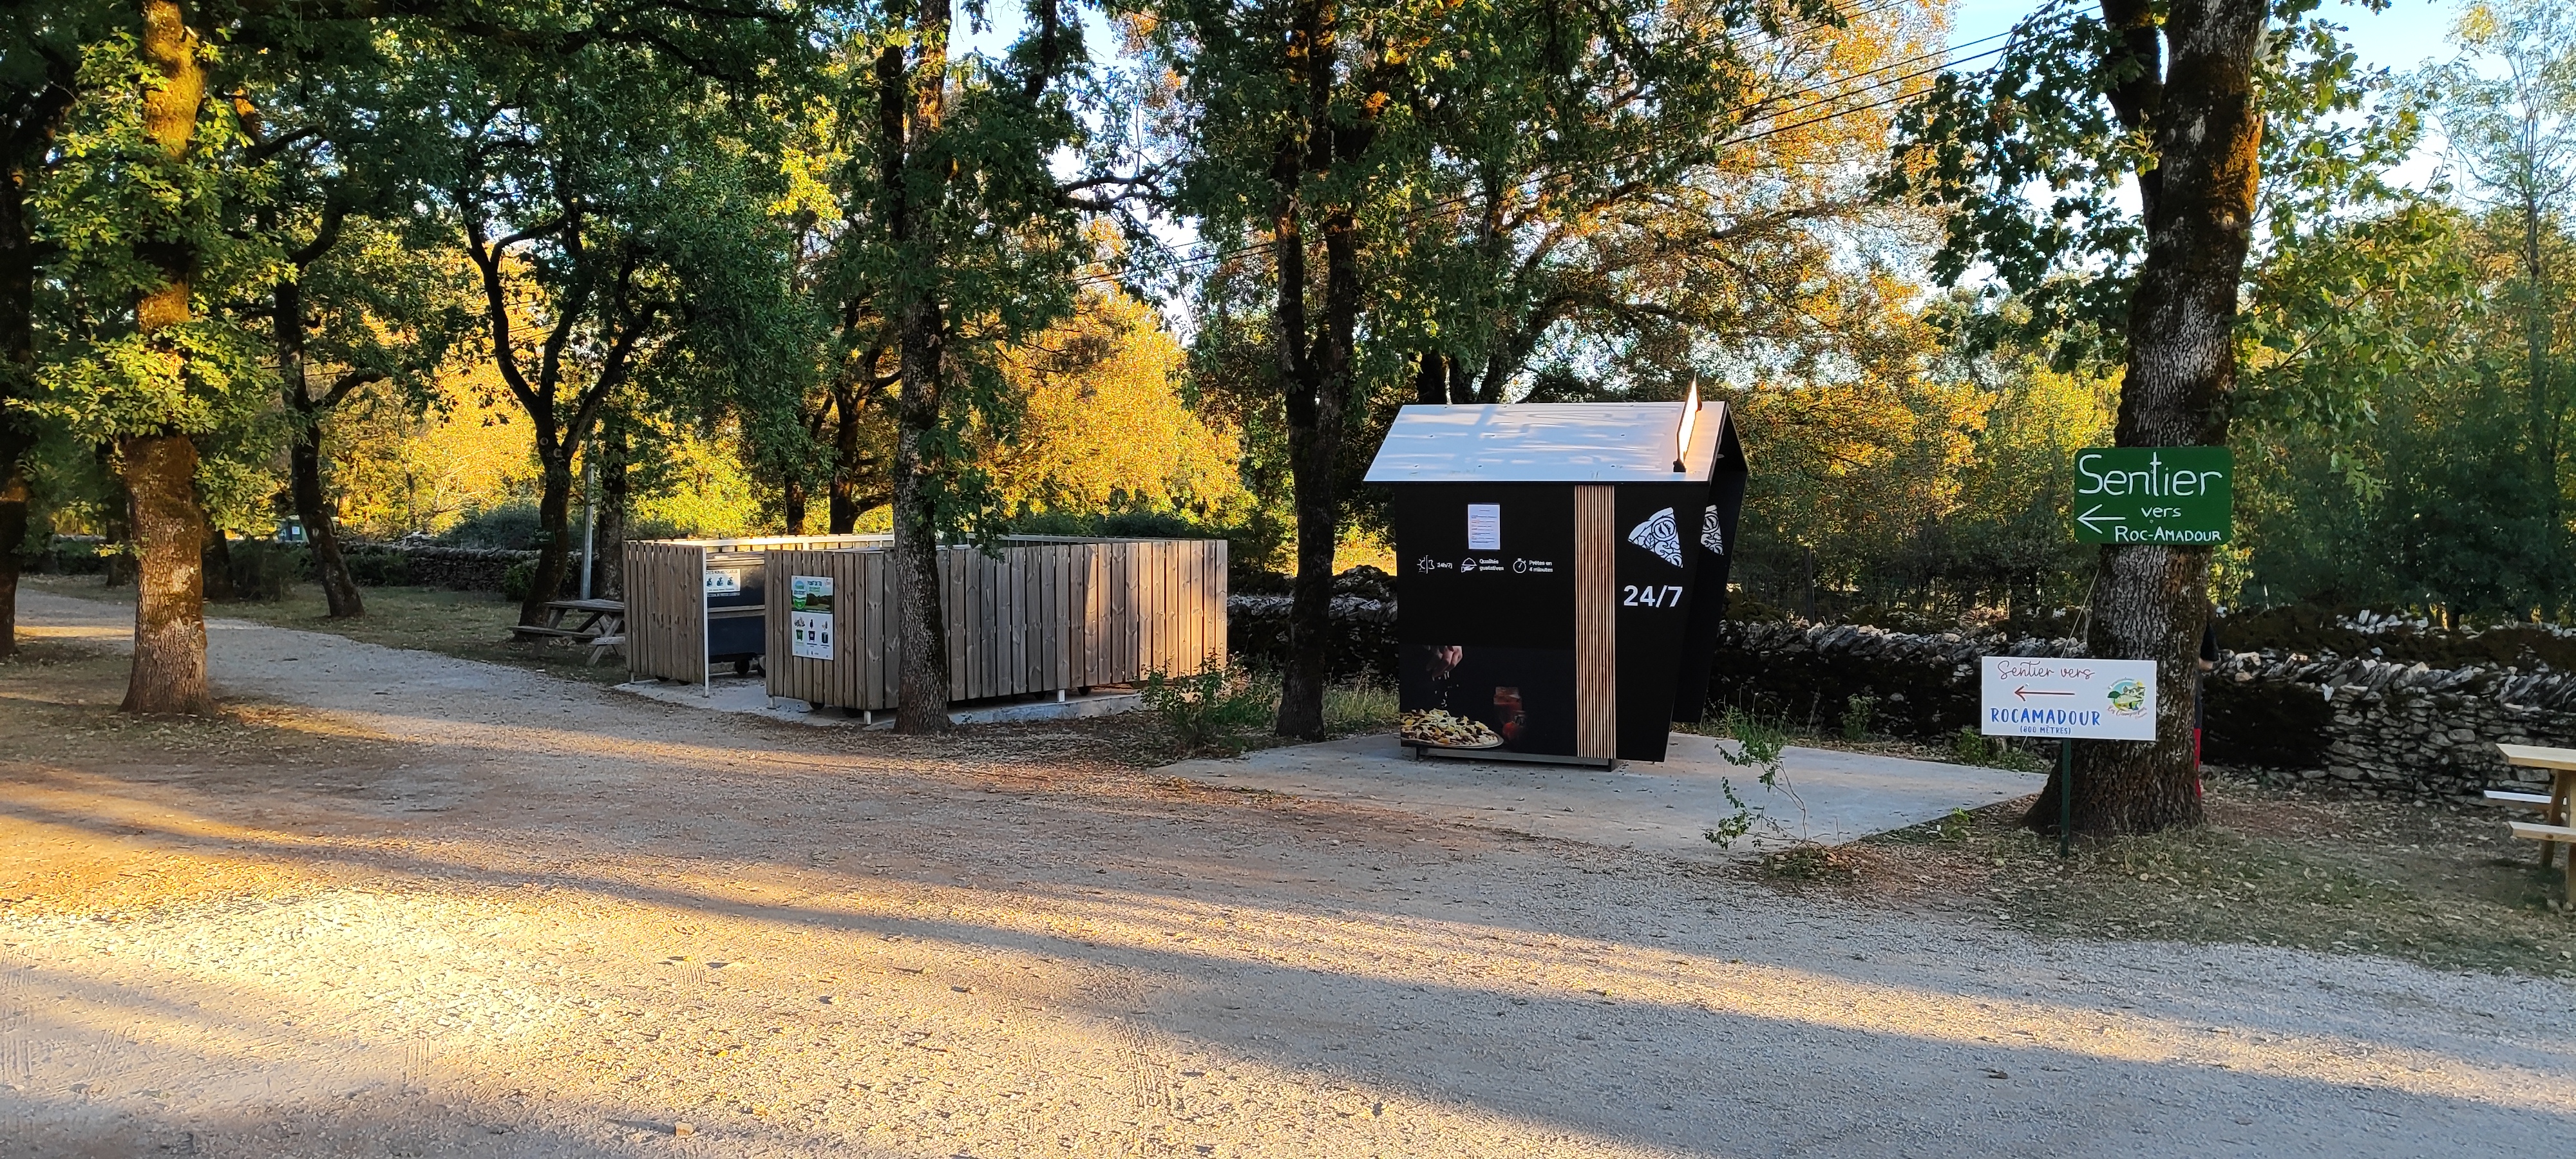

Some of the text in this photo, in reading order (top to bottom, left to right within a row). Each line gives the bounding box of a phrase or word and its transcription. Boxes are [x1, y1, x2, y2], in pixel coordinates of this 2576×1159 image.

[2078, 451, 2223, 496] Sentier
[2141, 507, 2182, 518] vers
[1624, 585, 1683, 608] 24/7
[1997, 660, 2096, 680] Sentier vers
[1991, 708, 2101, 726] ROCAMADOUR
[2040, 725, 2071, 735] MÈTRES)
